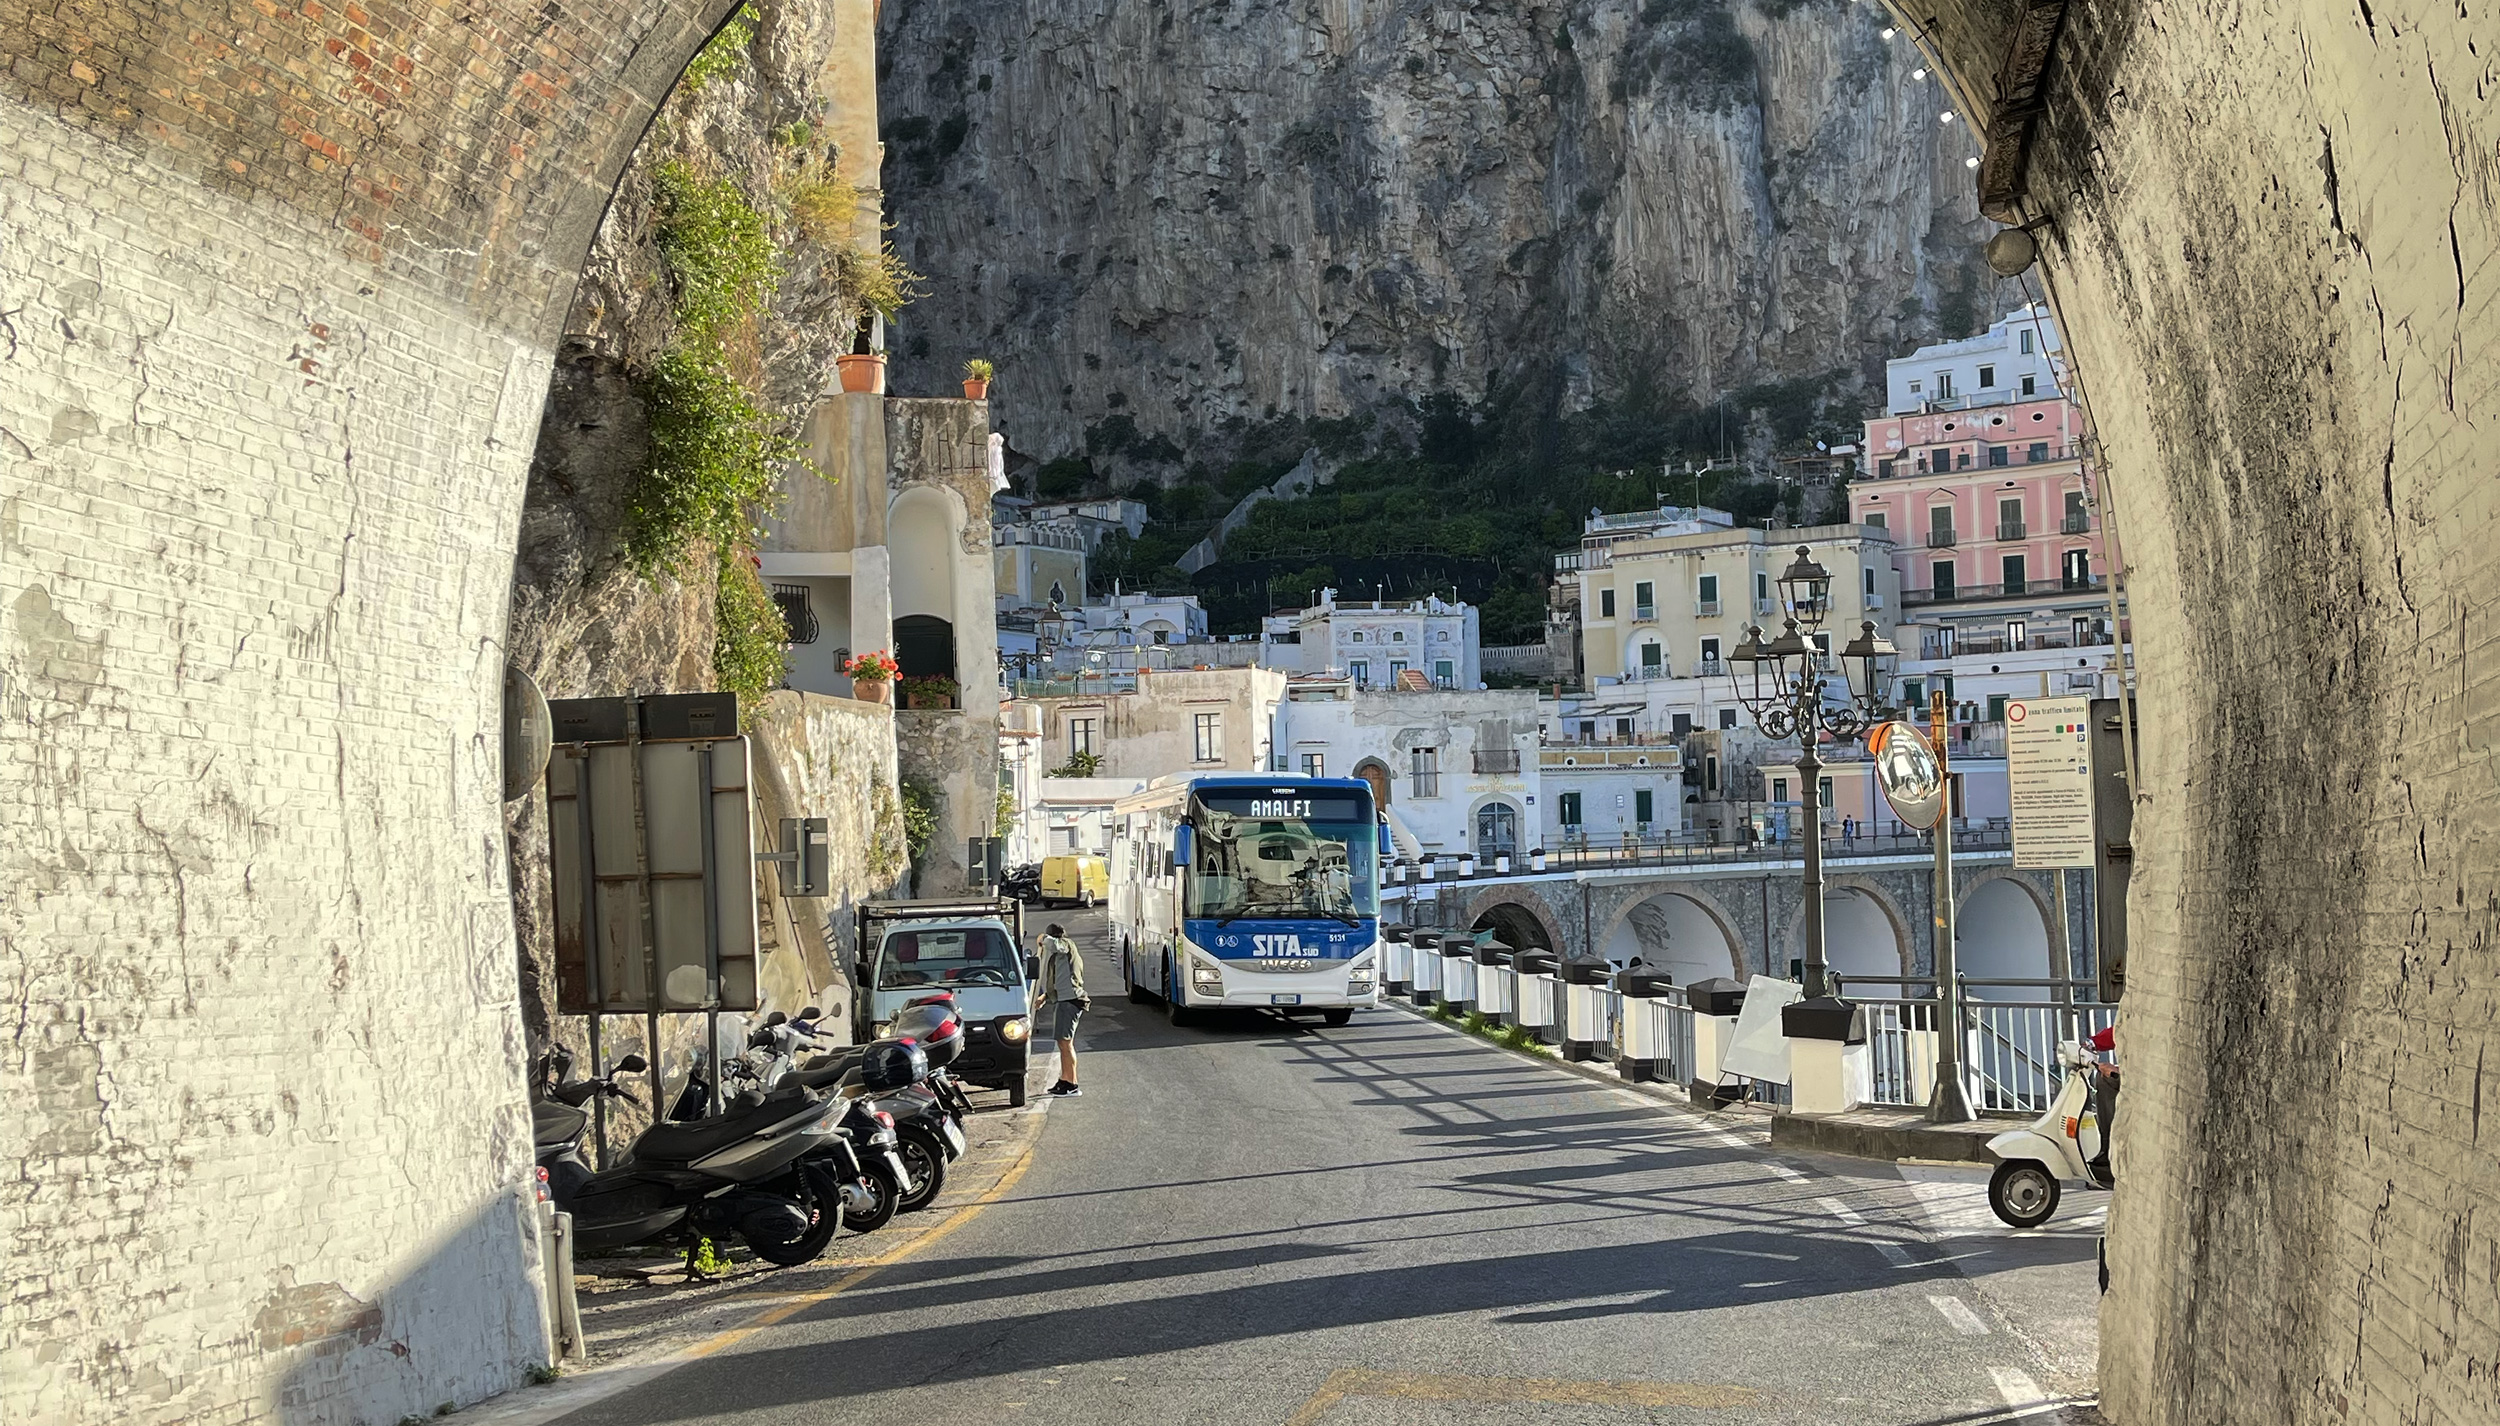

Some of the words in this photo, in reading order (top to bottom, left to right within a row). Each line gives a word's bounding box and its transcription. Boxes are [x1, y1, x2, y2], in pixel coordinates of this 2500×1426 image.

[2042, 707, 2063, 715] traffico
[1251, 800, 1311, 816] AMALFI
[1329, 934, 1346, 942] 5131
[1252, 934, 1302, 957] SITA
[1302, 948, 1319, 957] SUD
[1261, 959, 1312, 971] IVECO
